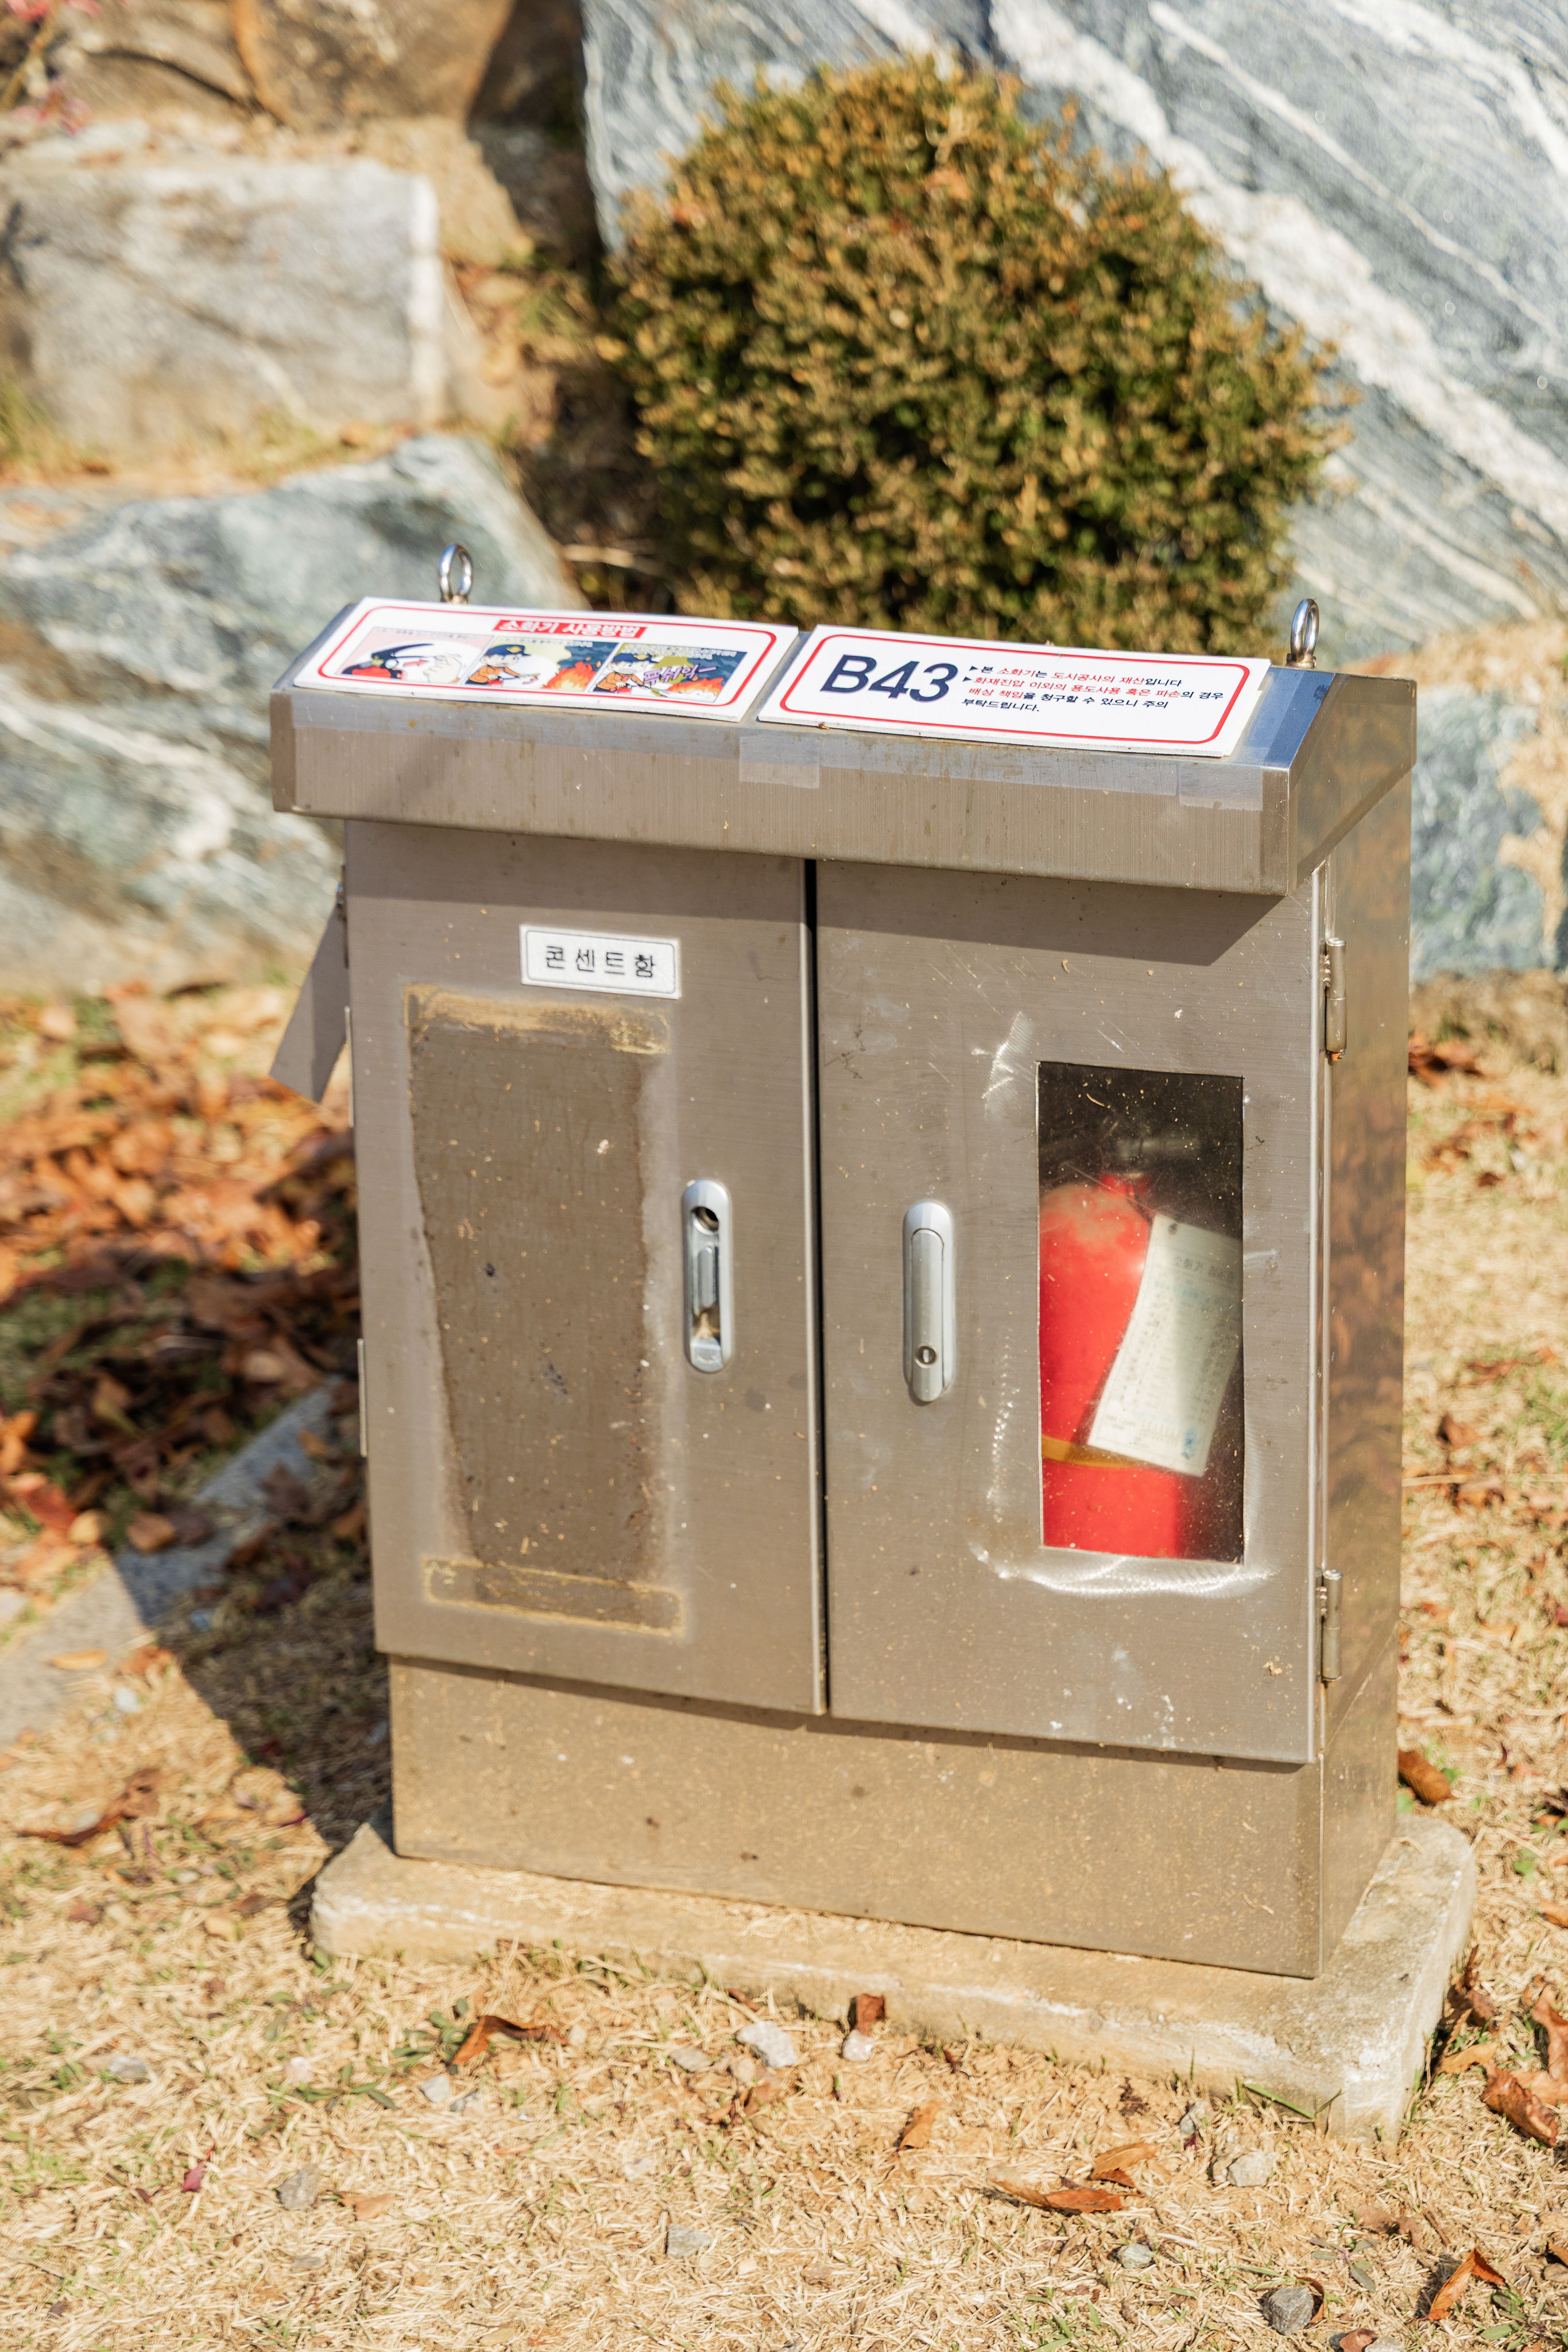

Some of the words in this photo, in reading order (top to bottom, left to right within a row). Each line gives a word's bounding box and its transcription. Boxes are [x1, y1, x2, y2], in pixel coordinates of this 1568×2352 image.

[499, 620, 559, 633] 소화기
[562, 622, 641, 639] 사용방법
[819, 654, 959, 703] B43
[997, 668, 1047, 678] 소화기는
[1051, 672, 1115, 683] 도시공사의
[1118, 676, 1182, 687] 재산입니다
[969, 688, 994, 697] 배상
[999, 690, 1036, 700] 책임을
[1040, 694, 1079, 703] 청구할
[1083, 697, 1095, 705] 수
[1100, 698, 1138, 707] 있으니
[1142, 701, 1169, 709] 주의
[974, 677, 1025, 687] 화재진압
[1029, 682, 1067, 691] 이외의
[1071, 685, 1121, 695] 용도사용
[1125, 688, 1151, 696] 혹은
[1155, 690, 1194, 698] 파손의
[1199, 692, 1224, 700] 경우
[962, 699, 1040, 712] 부탁드립니다.
[545, 946, 656, 978] 콘센트함
